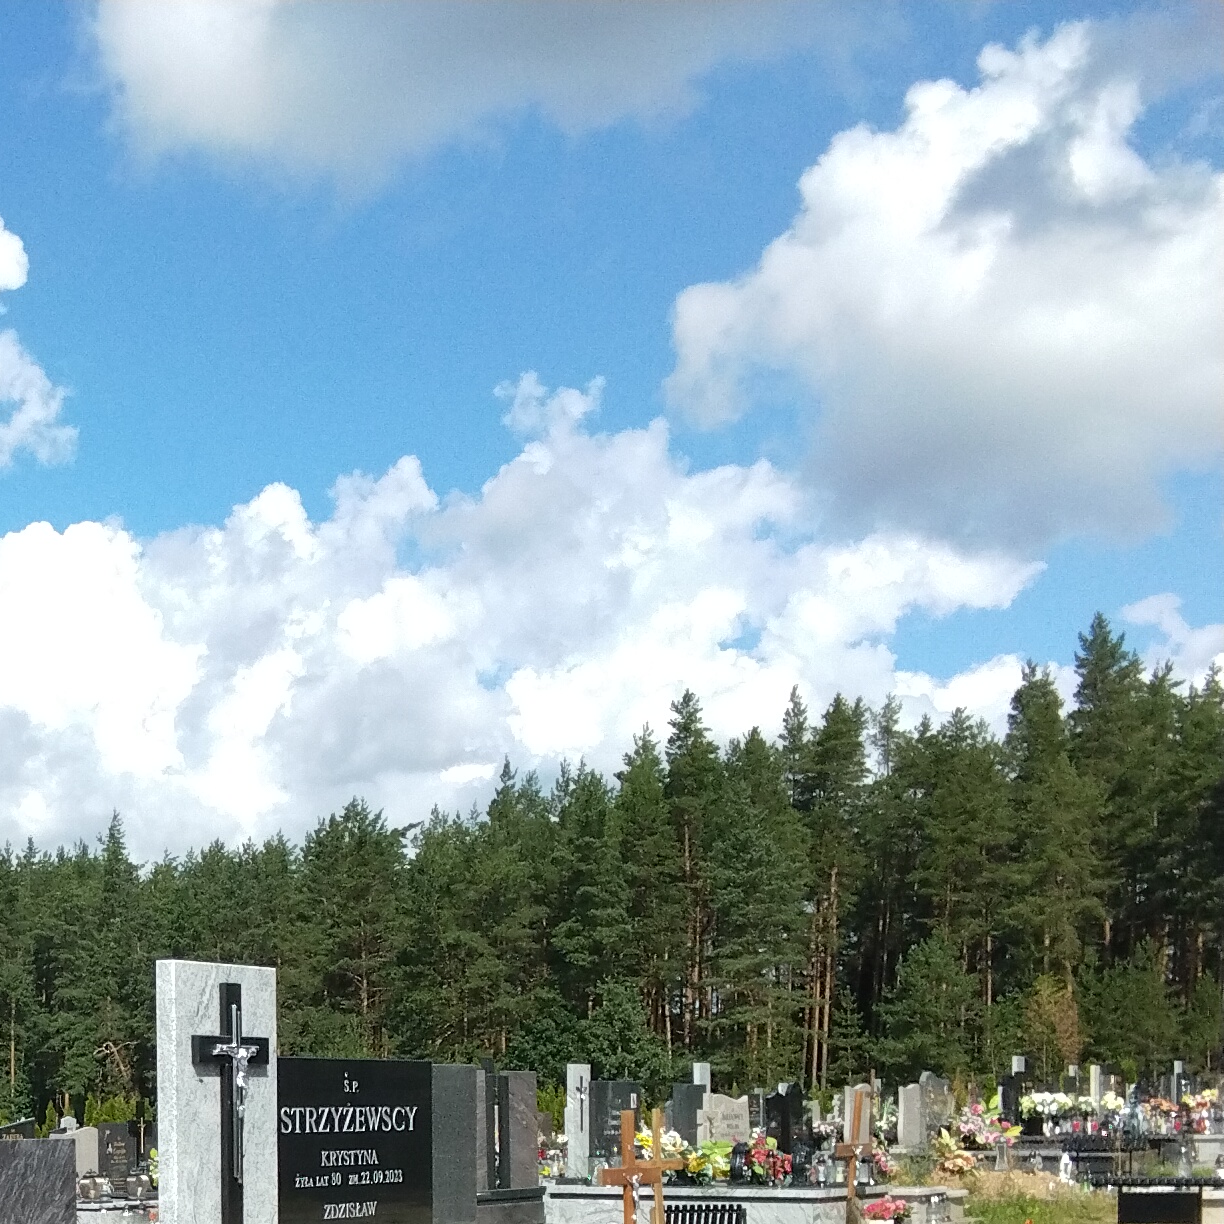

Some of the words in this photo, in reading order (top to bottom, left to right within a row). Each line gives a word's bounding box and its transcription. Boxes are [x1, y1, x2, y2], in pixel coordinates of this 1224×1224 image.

[280, 1102, 418, 1134] STRZYŻEWSCY
[320, 1149, 379, 1167] KRYSTYNA
[295, 1173, 314, 1188] ŻYŁA
[315, 1175, 330, 1187] LAT
[331, 1172, 342, 1186] 80
[323, 1201, 378, 1220] ZDZISŁAW
